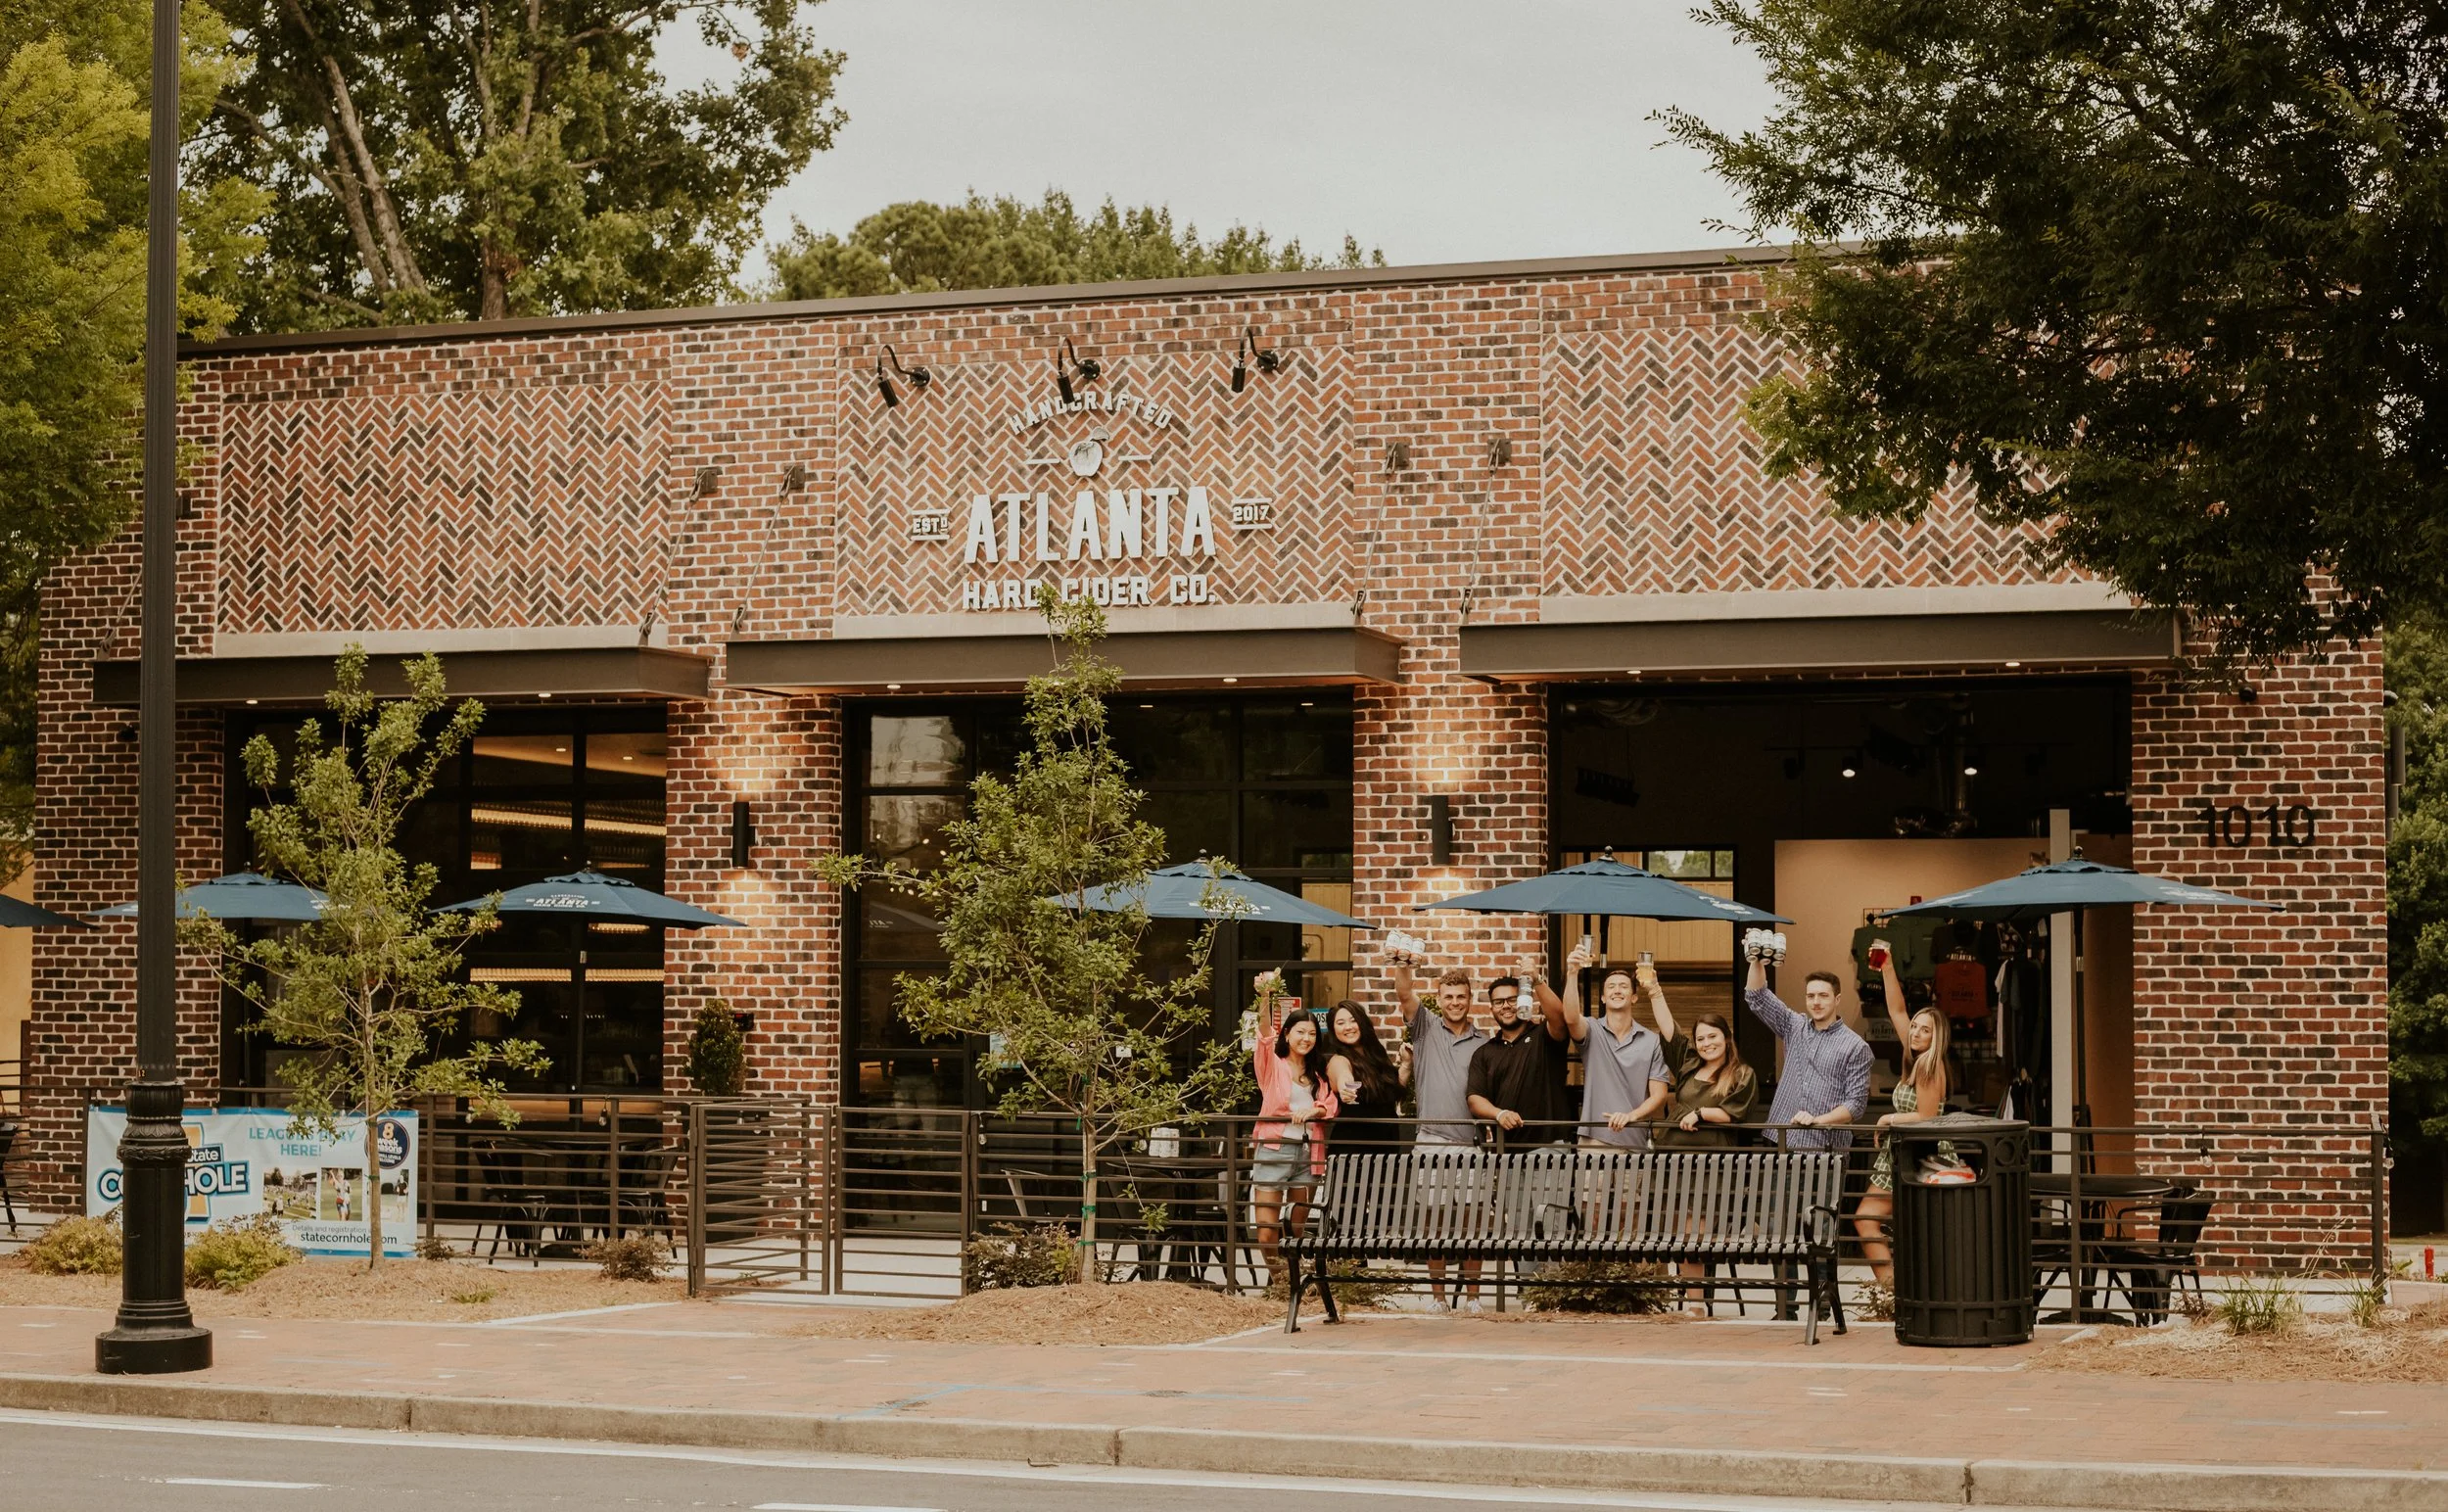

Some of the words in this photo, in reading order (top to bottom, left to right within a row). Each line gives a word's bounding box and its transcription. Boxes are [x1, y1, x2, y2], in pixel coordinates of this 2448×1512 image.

[1009, 391, 1172, 435] HANDCRAFTED
[964, 486, 1216, 563] ATLANTA
[1233, 504, 1270, 522] 2017
[963, 578, 1042, 610] HARD
[1061, 576, 1152, 606] CIDER
[1170, 574, 1216, 603] CO.
[2195, 804, 2315, 848] 1010
[383, 1122, 395, 1140] 8
[280, 1144, 322, 1157] HERE!
[99, 1163, 248, 1200] CHOLE
[300, 1232, 398, 1245] statecornholeom
[328, 1225, 367, 1234] registration
